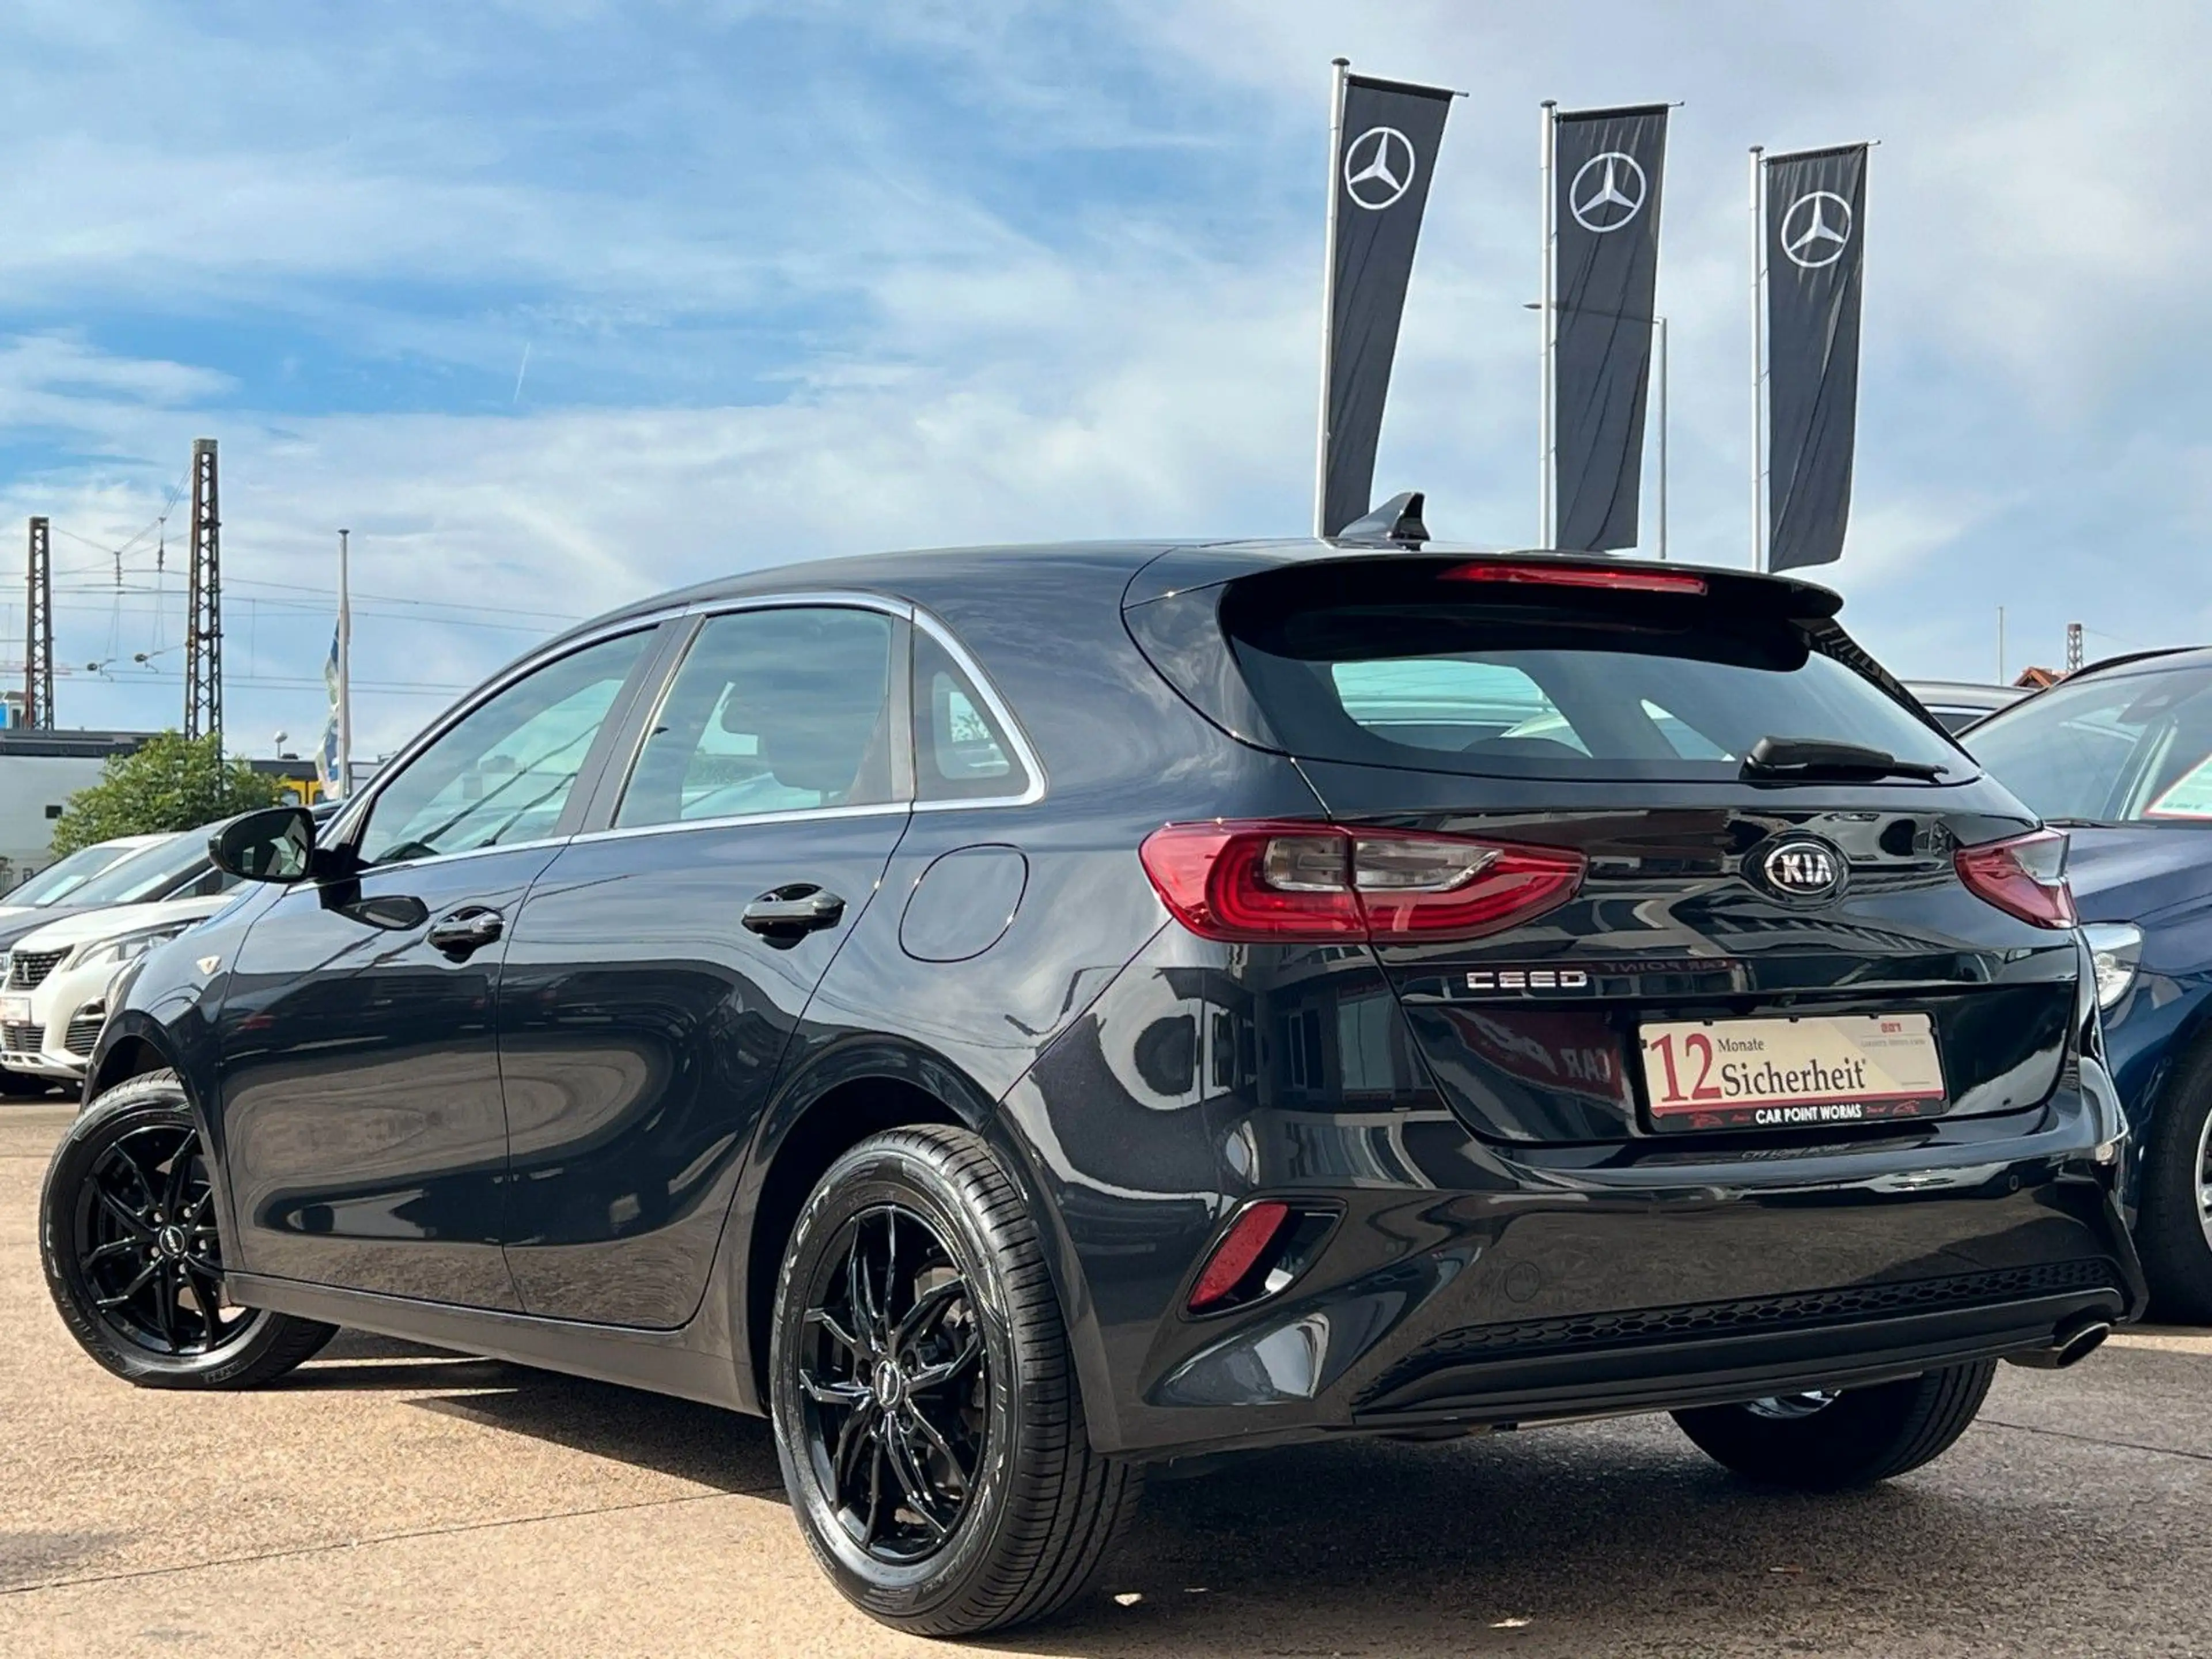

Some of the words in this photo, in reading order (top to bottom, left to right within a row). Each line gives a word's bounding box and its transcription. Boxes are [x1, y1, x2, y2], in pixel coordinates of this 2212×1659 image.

[1781, 854, 1832, 883] KIA
[1467, 971, 1588, 988] CEED
[1717, 1037, 1765, 1053] Monate
[1650, 1033, 1722, 1102] 12
[1756, 1109, 1782, 1124] CAR
[1784, 1106, 1819, 1123] POINT
[1819, 1103, 1862, 1120] WORMS
